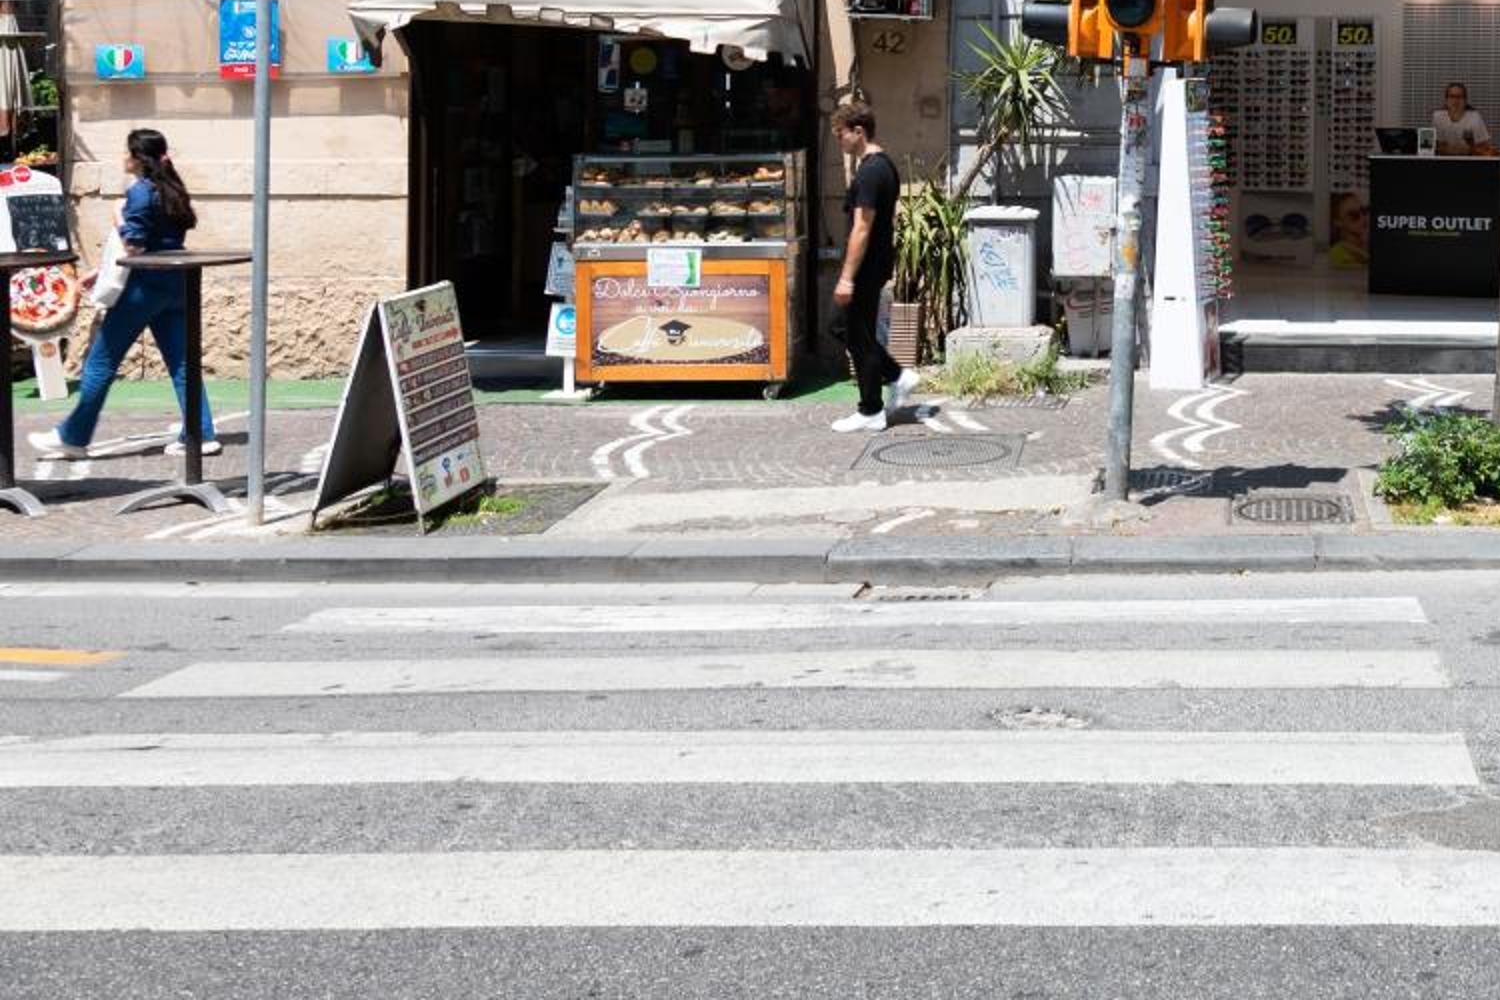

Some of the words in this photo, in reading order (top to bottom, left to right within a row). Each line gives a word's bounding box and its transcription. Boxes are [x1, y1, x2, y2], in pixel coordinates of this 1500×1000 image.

[872, 32, 905, 55] 42
[1377, 215, 1427, 229] SUPER
[1431, 216, 1492, 231] OUTLET
